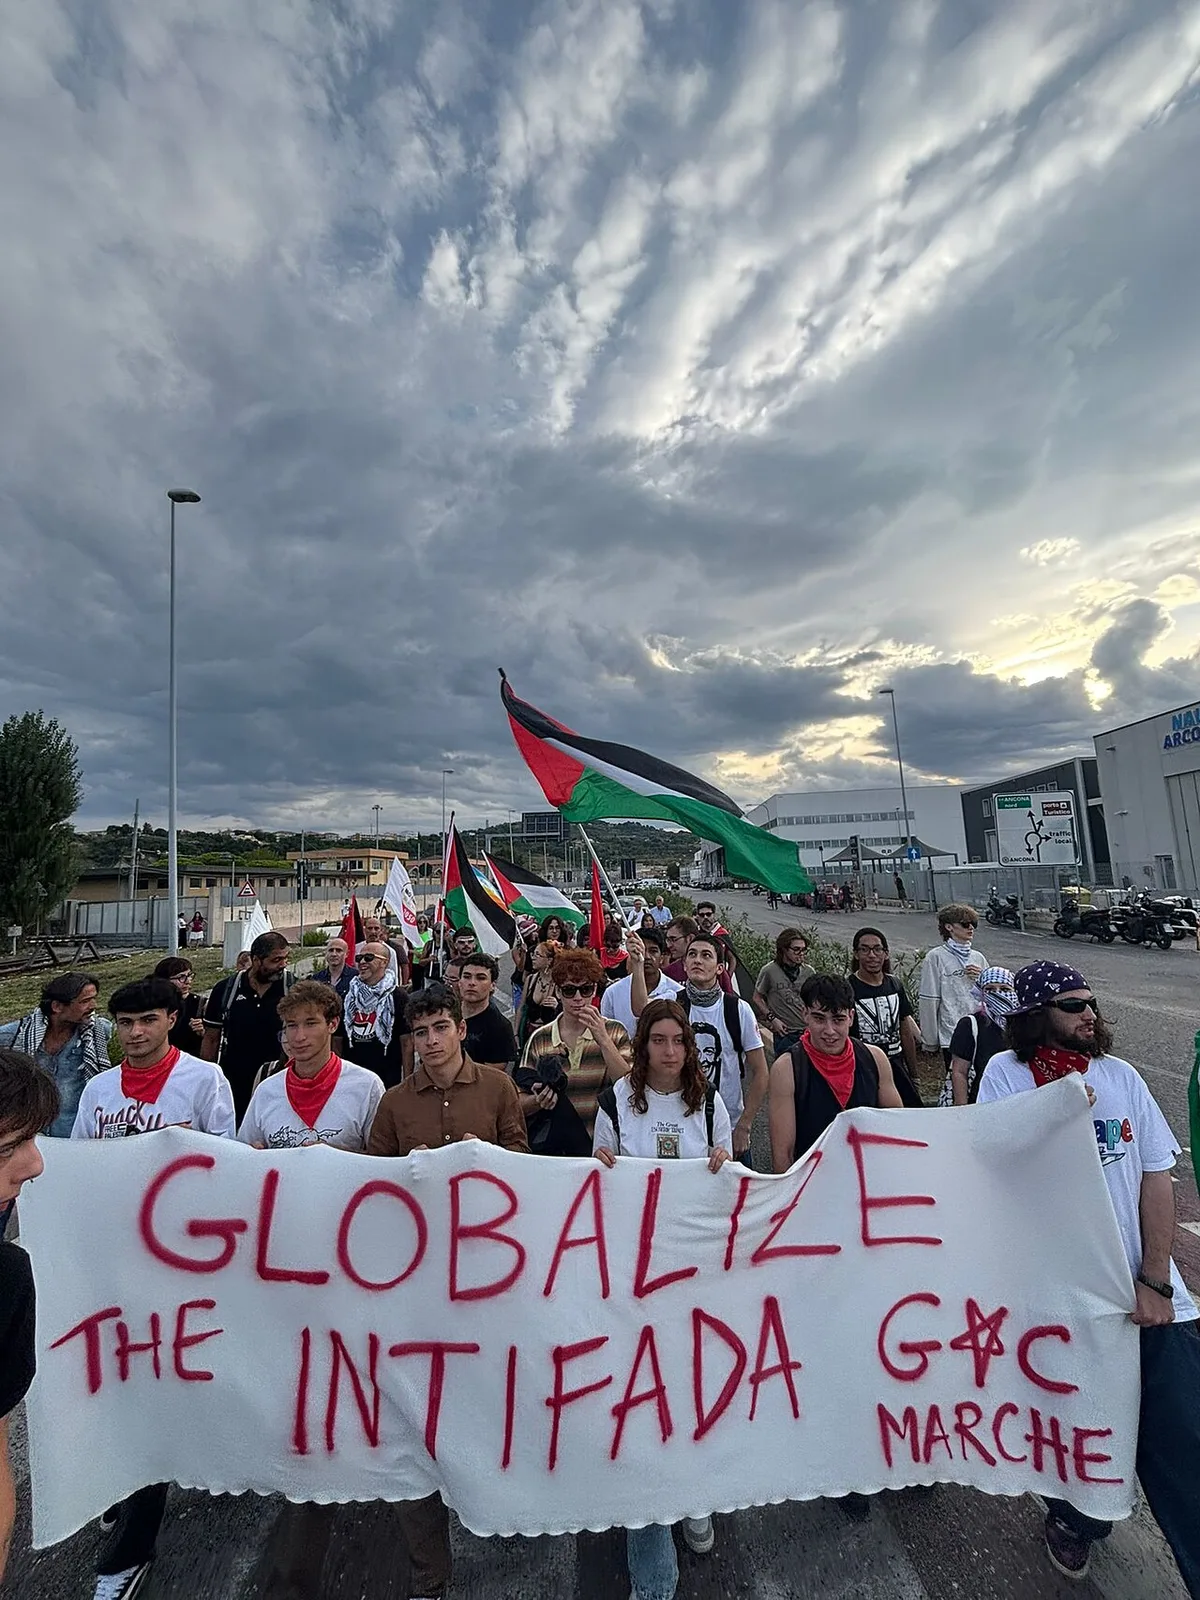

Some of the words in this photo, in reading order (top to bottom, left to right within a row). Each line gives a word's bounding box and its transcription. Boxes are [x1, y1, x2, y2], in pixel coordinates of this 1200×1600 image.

[139, 1127, 943, 1303] GLOBALIZE
[50, 1298, 225, 1395] THE
[290, 1296, 804, 1471] INTIFADA
[877, 1401, 1125, 1485] MARCHE
